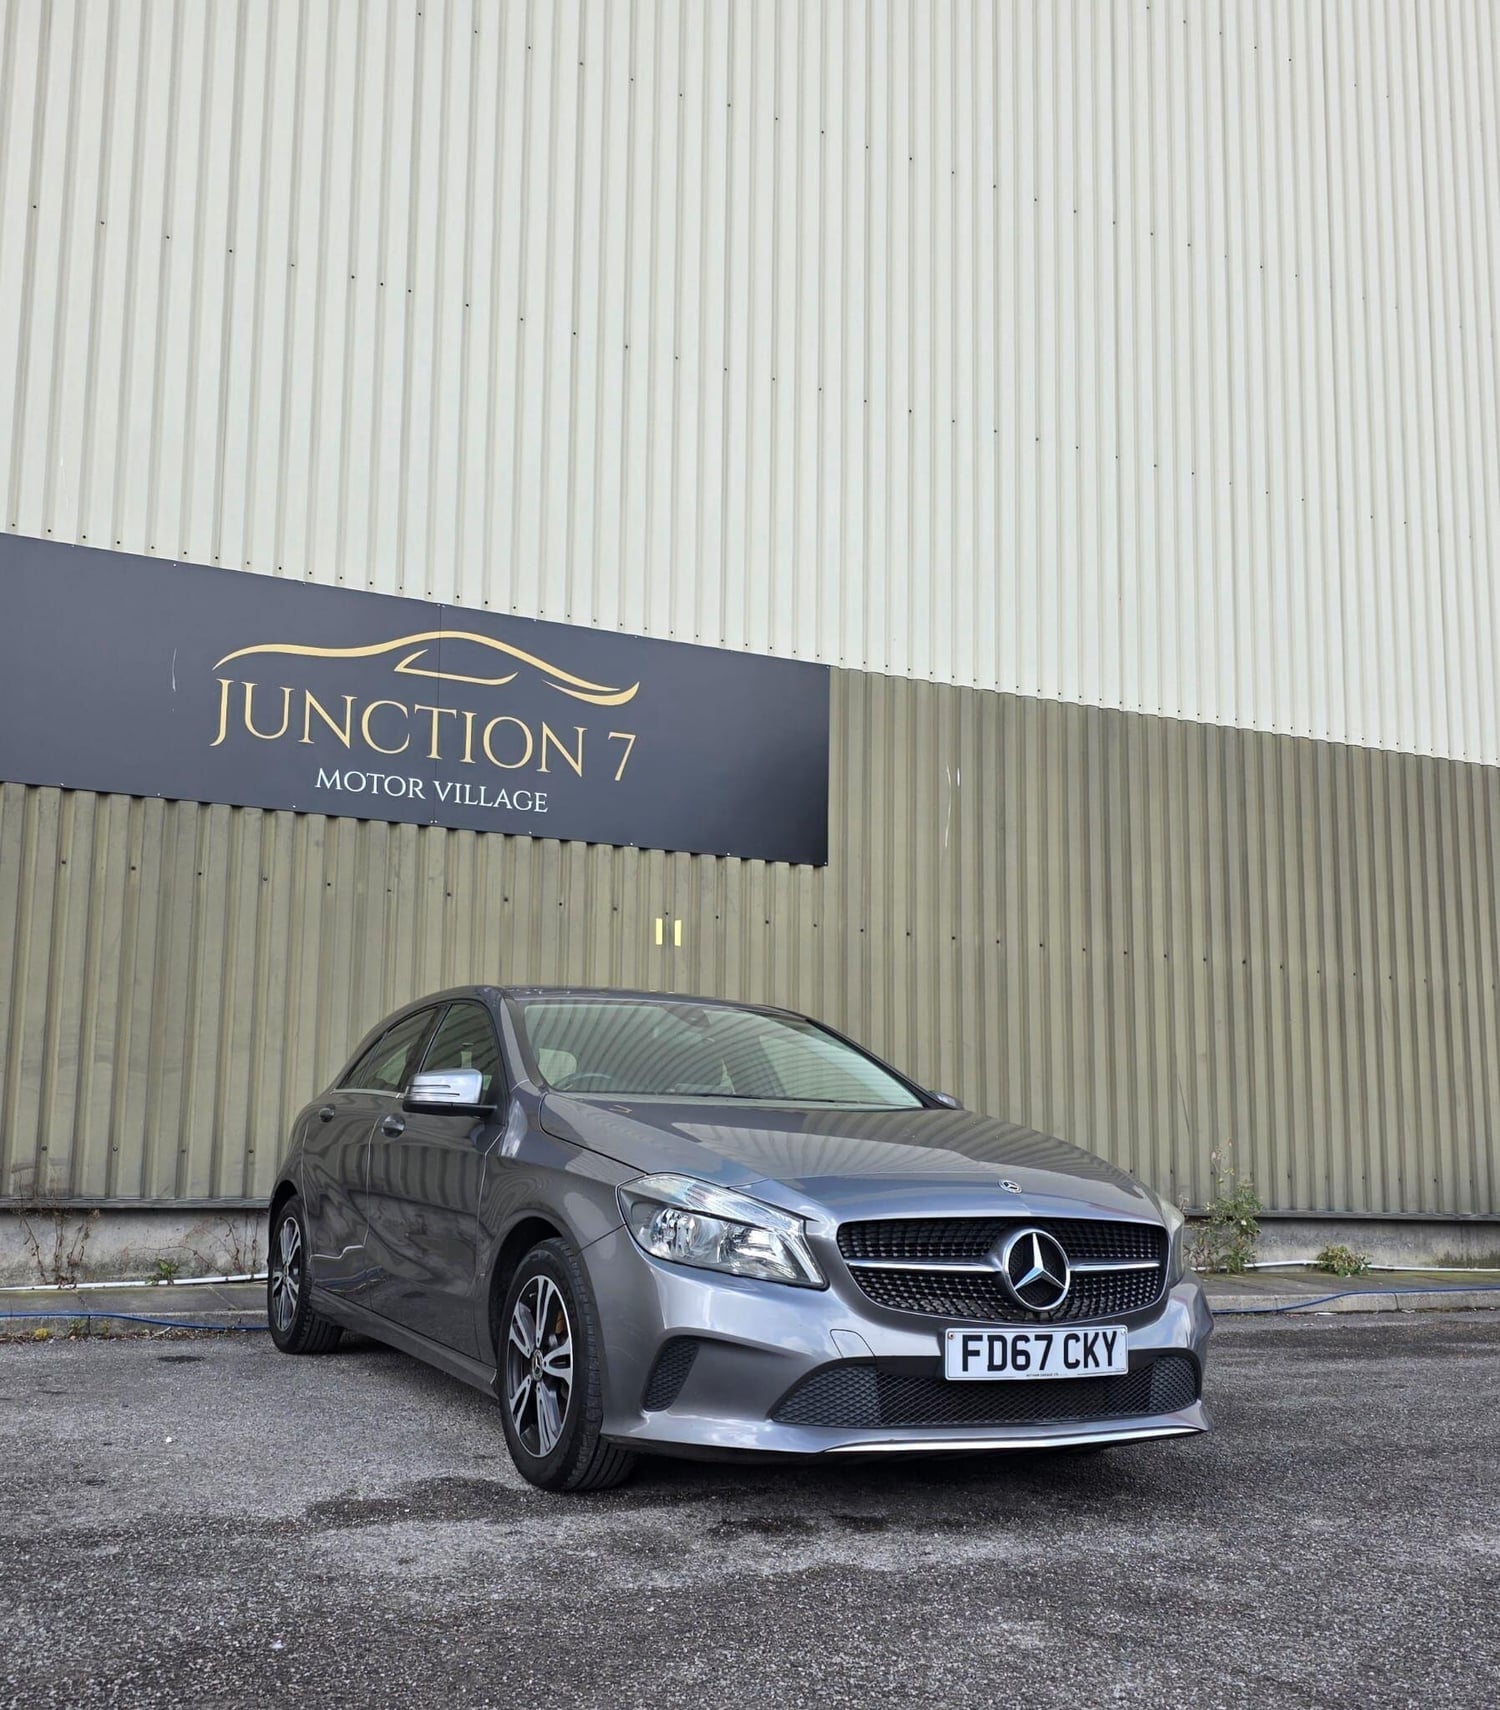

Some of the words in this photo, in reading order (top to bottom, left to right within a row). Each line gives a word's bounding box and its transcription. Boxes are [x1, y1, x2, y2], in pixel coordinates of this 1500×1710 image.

[209, 678, 588, 777] JUNCTION
[607, 731, 637, 782] 7
[315, 767, 426, 800] MOTOR
[433, 780, 548, 813] VILLAGE
[962, 1334, 1053, 1372] FD67
[1063, 1330, 1117, 1369] CKY
